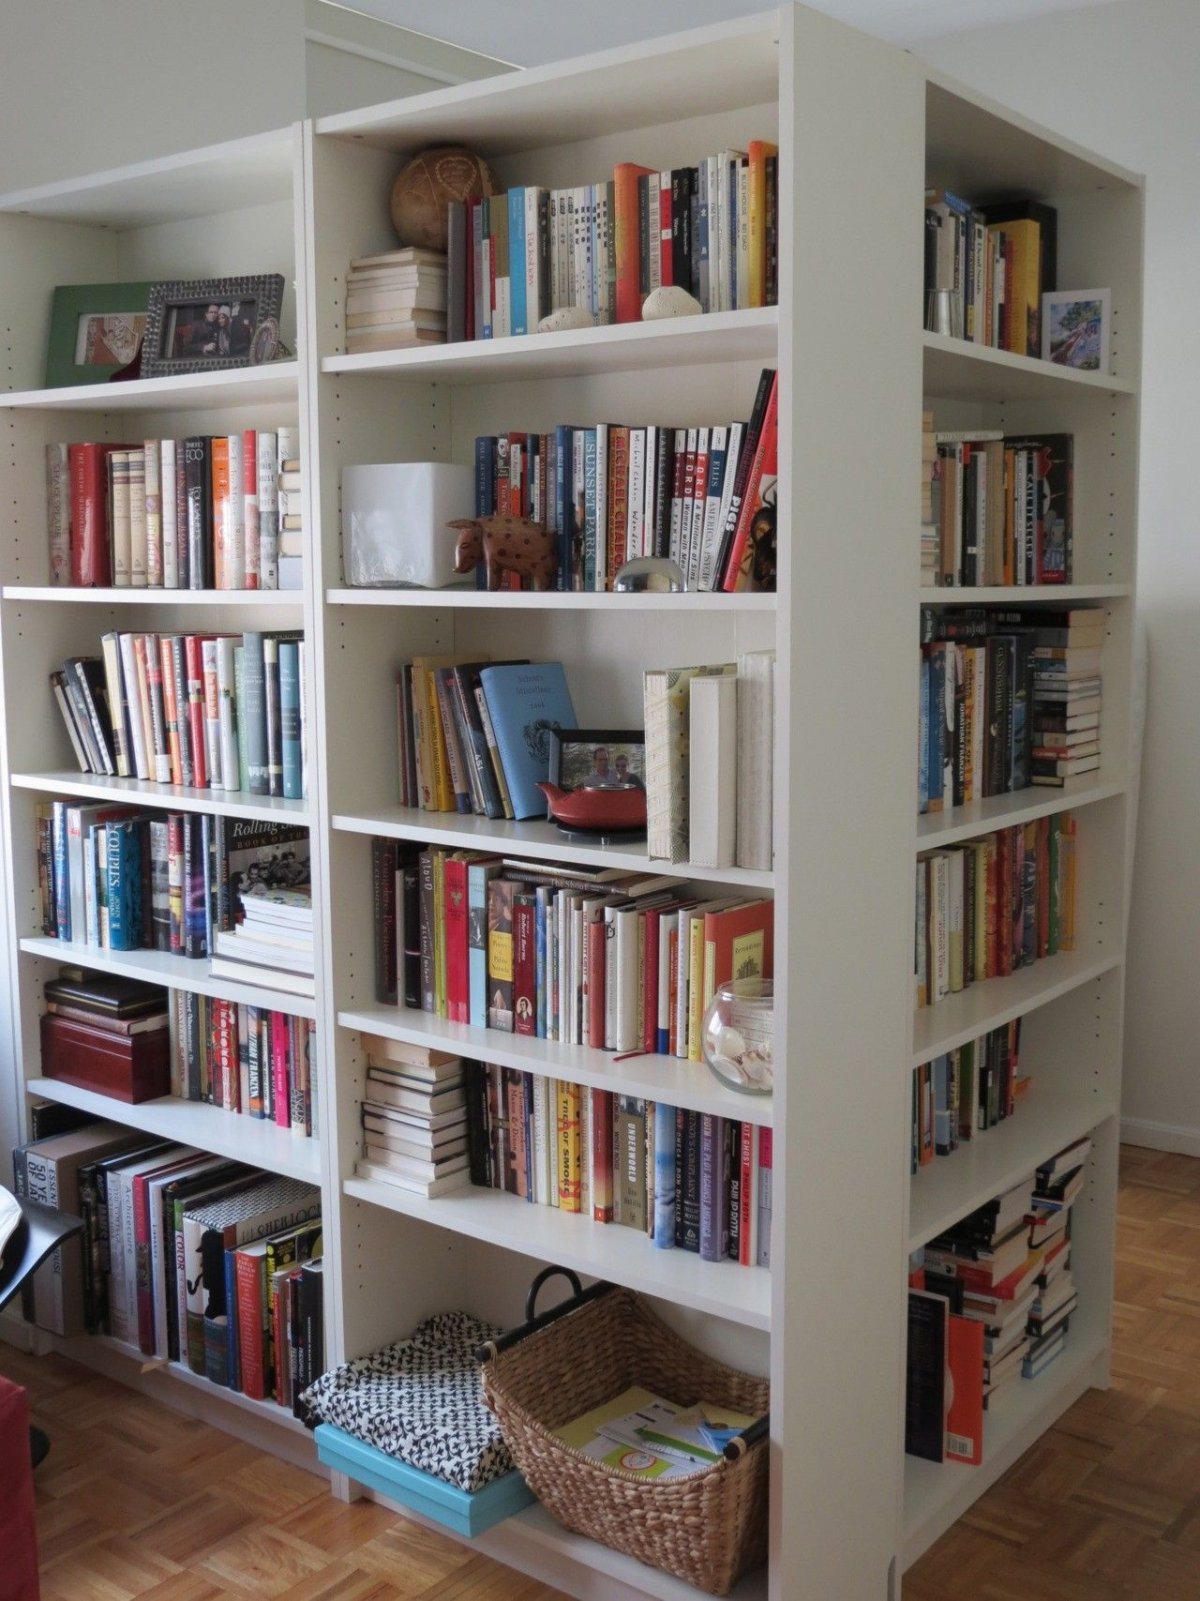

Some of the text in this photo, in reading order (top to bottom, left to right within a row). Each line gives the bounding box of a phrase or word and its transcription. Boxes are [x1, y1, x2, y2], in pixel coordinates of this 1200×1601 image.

[659, 435, 667, 468] JAMES
[729, 425, 739, 457] MICHAEL
[179, 471, 186, 482] ON
[615, 436, 626, 506] MICHAEL
[695, 455, 705, 497] FORD
[722, 459, 735, 509] CUNNINGHAM
[51, 462, 62, 539] SHAKESPEARE
[179, 490, 187, 513] THE
[585, 442, 596, 560] SUNSET PARK
[631, 433, 641, 549] Michael Chabon Wonder
[658, 474, 667, 511] SALTER
[680, 454, 694, 570] FORD Women with Men
[702, 460, 721, 586] ELLIS AMERICAN PSYCHO
[725, 495, 742, 532] PIGS
[1026, 473, 1034, 559] CALL IT SLEEP
[656, 535, 664, 557] NIGH
[691, 513, 702, 549] Multitude
[689, 564, 698, 580] Sins
[690, 553, 698, 561] of
[232, 820, 278, 838] Rolling
[237, 838, 266, 849] BOOK
[271, 835, 286, 843] OF
[109, 830, 121, 887] COUPLES
[380, 853, 393, 951] Complete Poems
[248, 1060, 259, 1098] FRANZEN
[294, 1090, 305, 1124] ANGUS
[510, 1089, 519, 1114] Mason
[511, 1128, 519, 1152] Dixon
[562, 1100, 571, 1195] TREE OF SMOKE
[627, 1122, 637, 1184] UNDERWORLD
[28, 1161, 39, 1177] OF
[37, 1165, 47, 1181] 50
[687, 1146, 697, 1200] COMPLAINT
[703, 1116, 713, 1238] ROTH THE PLOT AGAINST AMERICA
[124, 1186, 133, 1255] Architecture
[730, 1180, 739, 1237] PHILIP ROTH
[176, 1234, 185, 1271] COLOR
